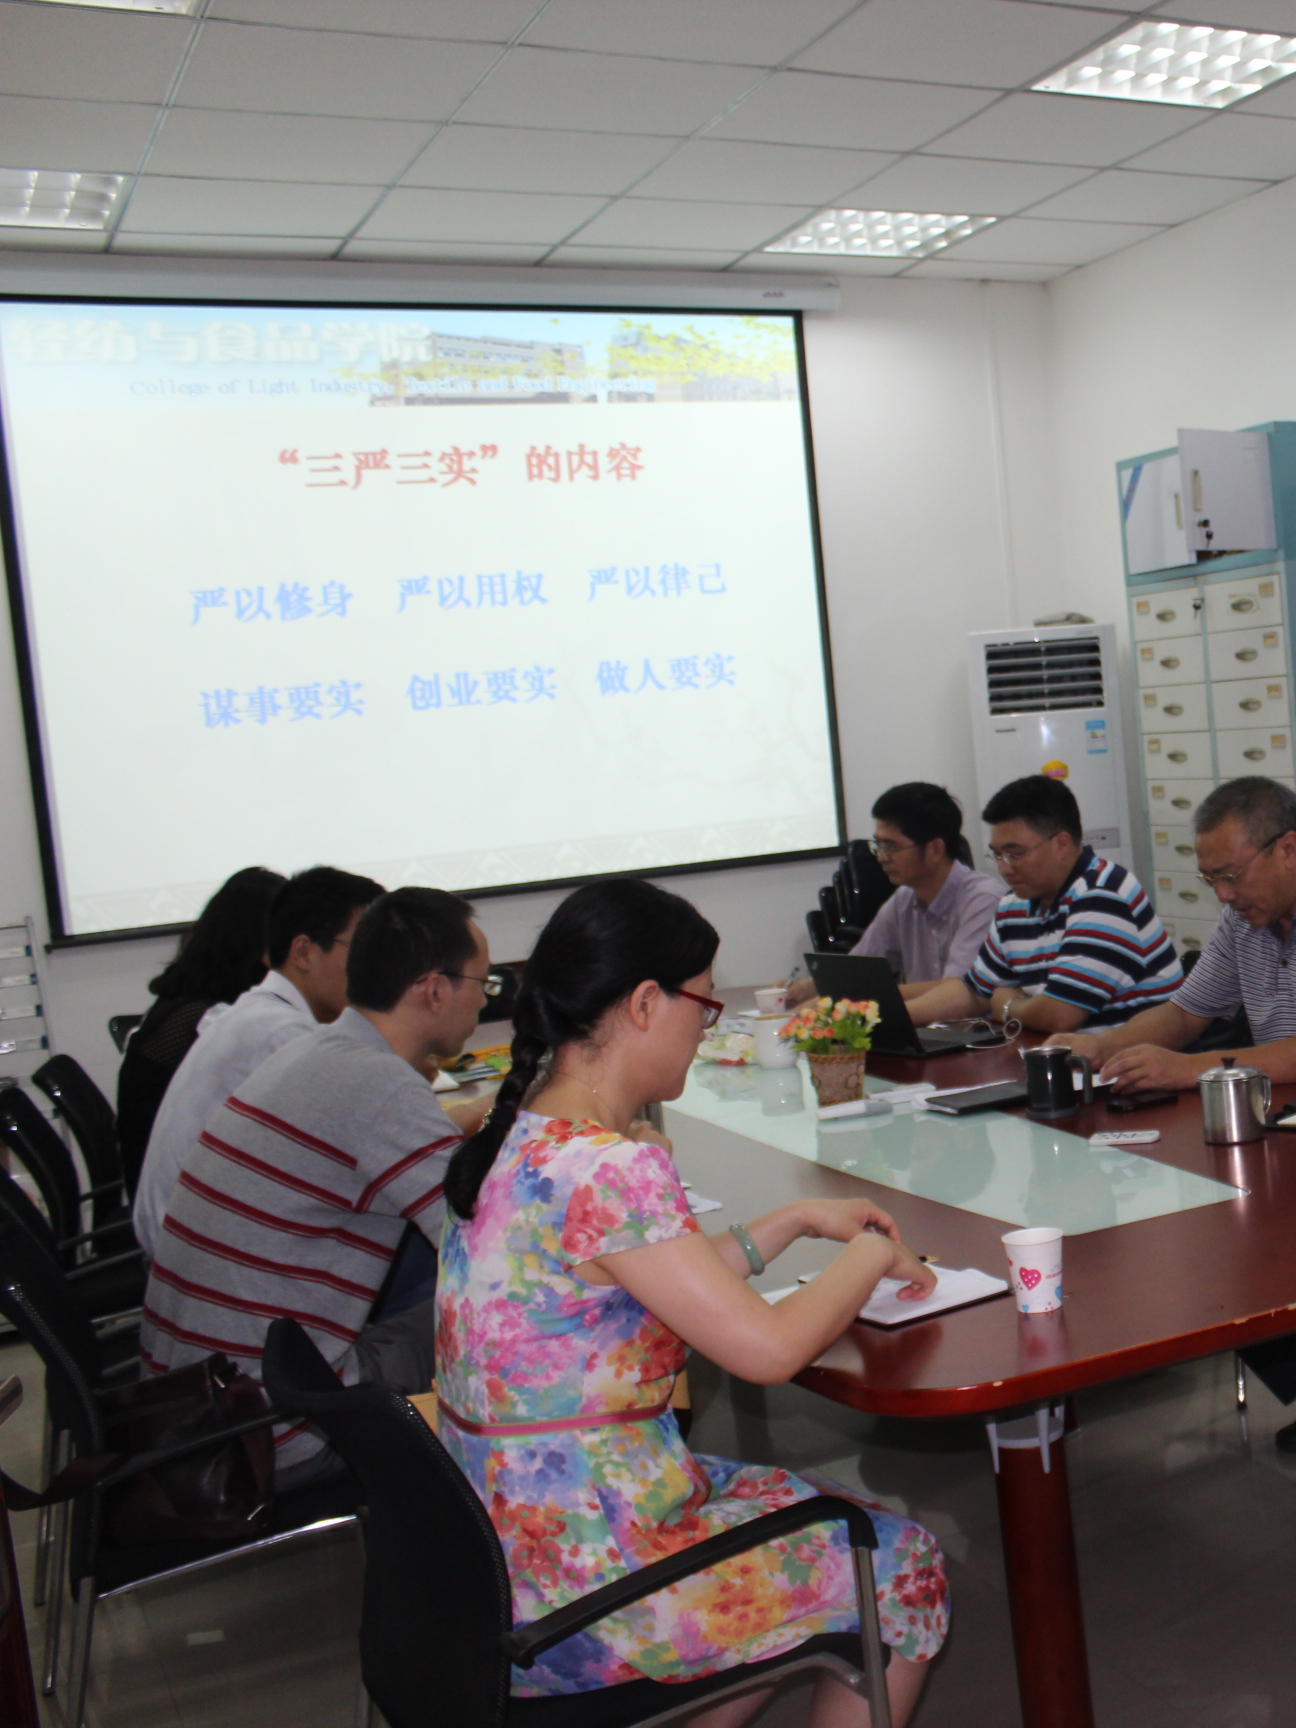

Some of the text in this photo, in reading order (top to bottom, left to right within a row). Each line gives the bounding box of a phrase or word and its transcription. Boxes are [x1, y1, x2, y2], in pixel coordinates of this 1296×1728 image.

[130, 378, 213, 397] College
[219, 378, 240, 394] of
[249, 379, 299, 397] Light
[190, 562, 729, 626] 严以修身 严以用权 严以律己
[199, 652, 737, 729] 谋事要实 创业要实 做人要实
